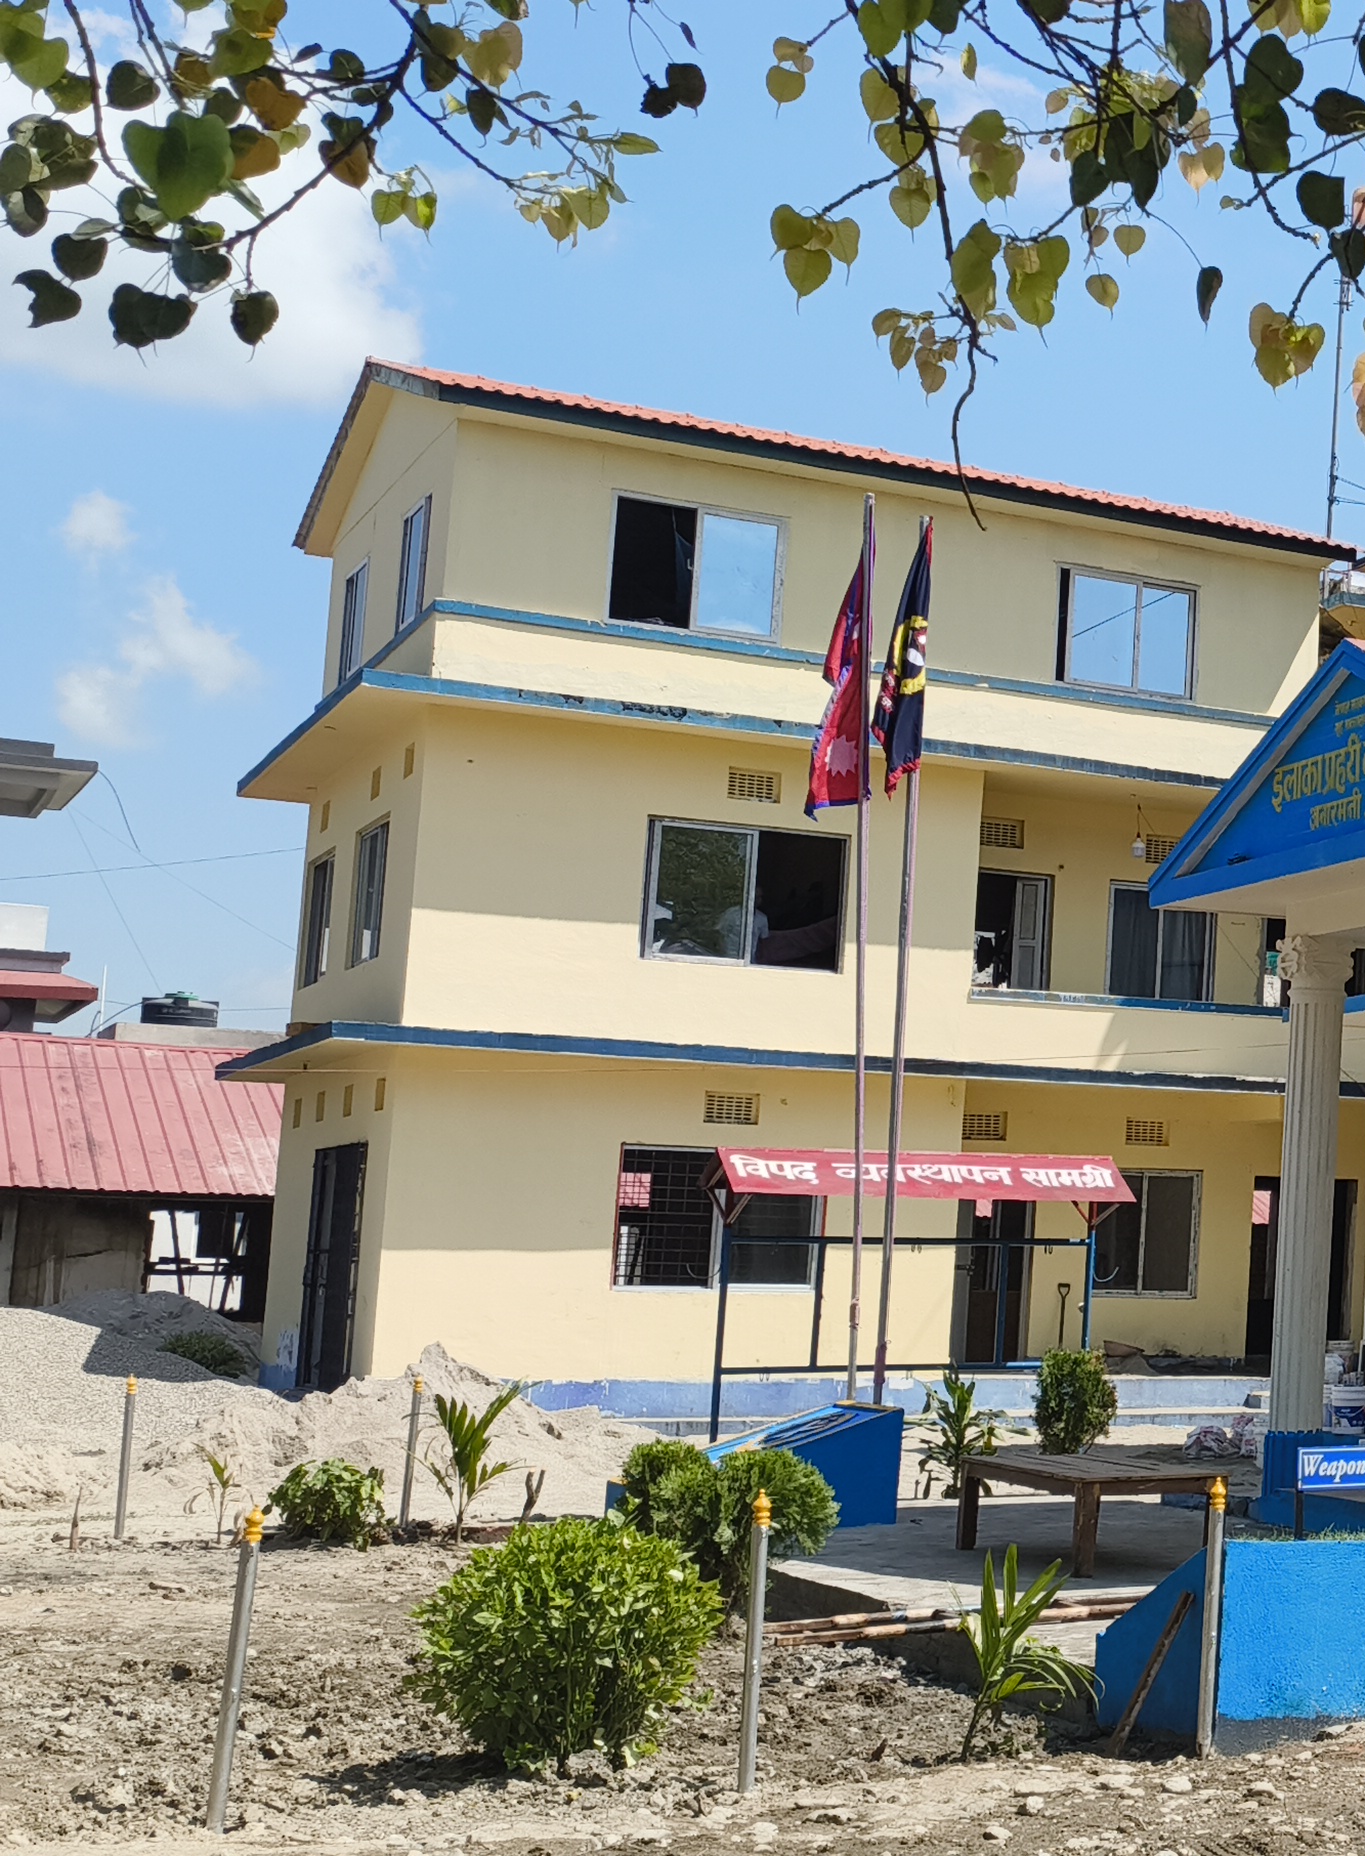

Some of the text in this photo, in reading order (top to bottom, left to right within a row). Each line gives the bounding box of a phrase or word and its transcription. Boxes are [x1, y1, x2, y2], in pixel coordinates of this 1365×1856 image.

[1272, 754, 1323, 813] इलाका
[1322, 732, 1362, 795] प्रहरी
[831, 1162, 1013, 1186] व्यवस्थापन
[1019, 1164, 1116, 1189] सामग्री
